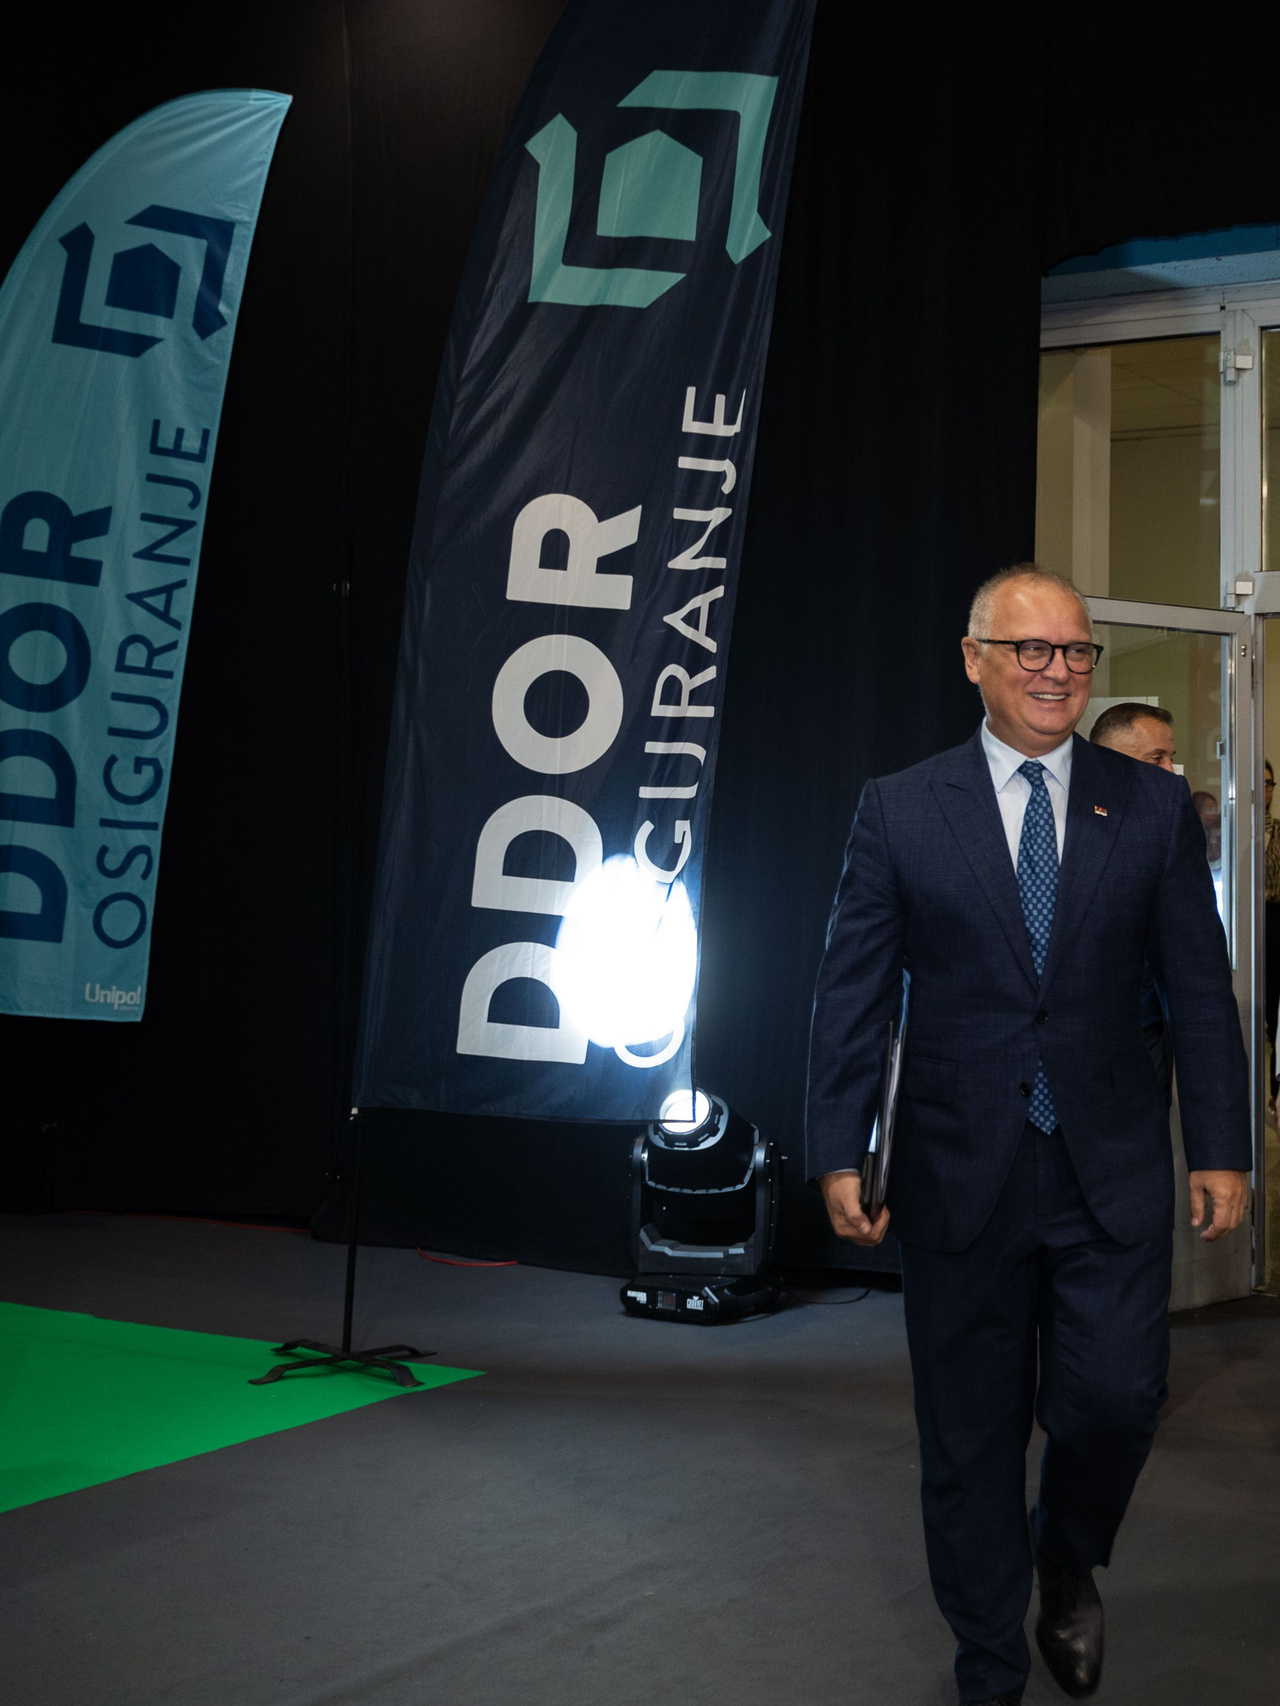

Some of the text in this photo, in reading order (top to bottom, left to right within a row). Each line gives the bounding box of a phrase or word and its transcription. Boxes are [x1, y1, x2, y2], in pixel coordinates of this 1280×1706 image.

[0, 490, 113, 943] DDOR
[92, 418, 211, 949] OSIGURANJE
[456, 493, 642, 1065] DDOR
[615, 386, 746, 1068] GURANJE
[85, 983, 142, 1010] Unipol
